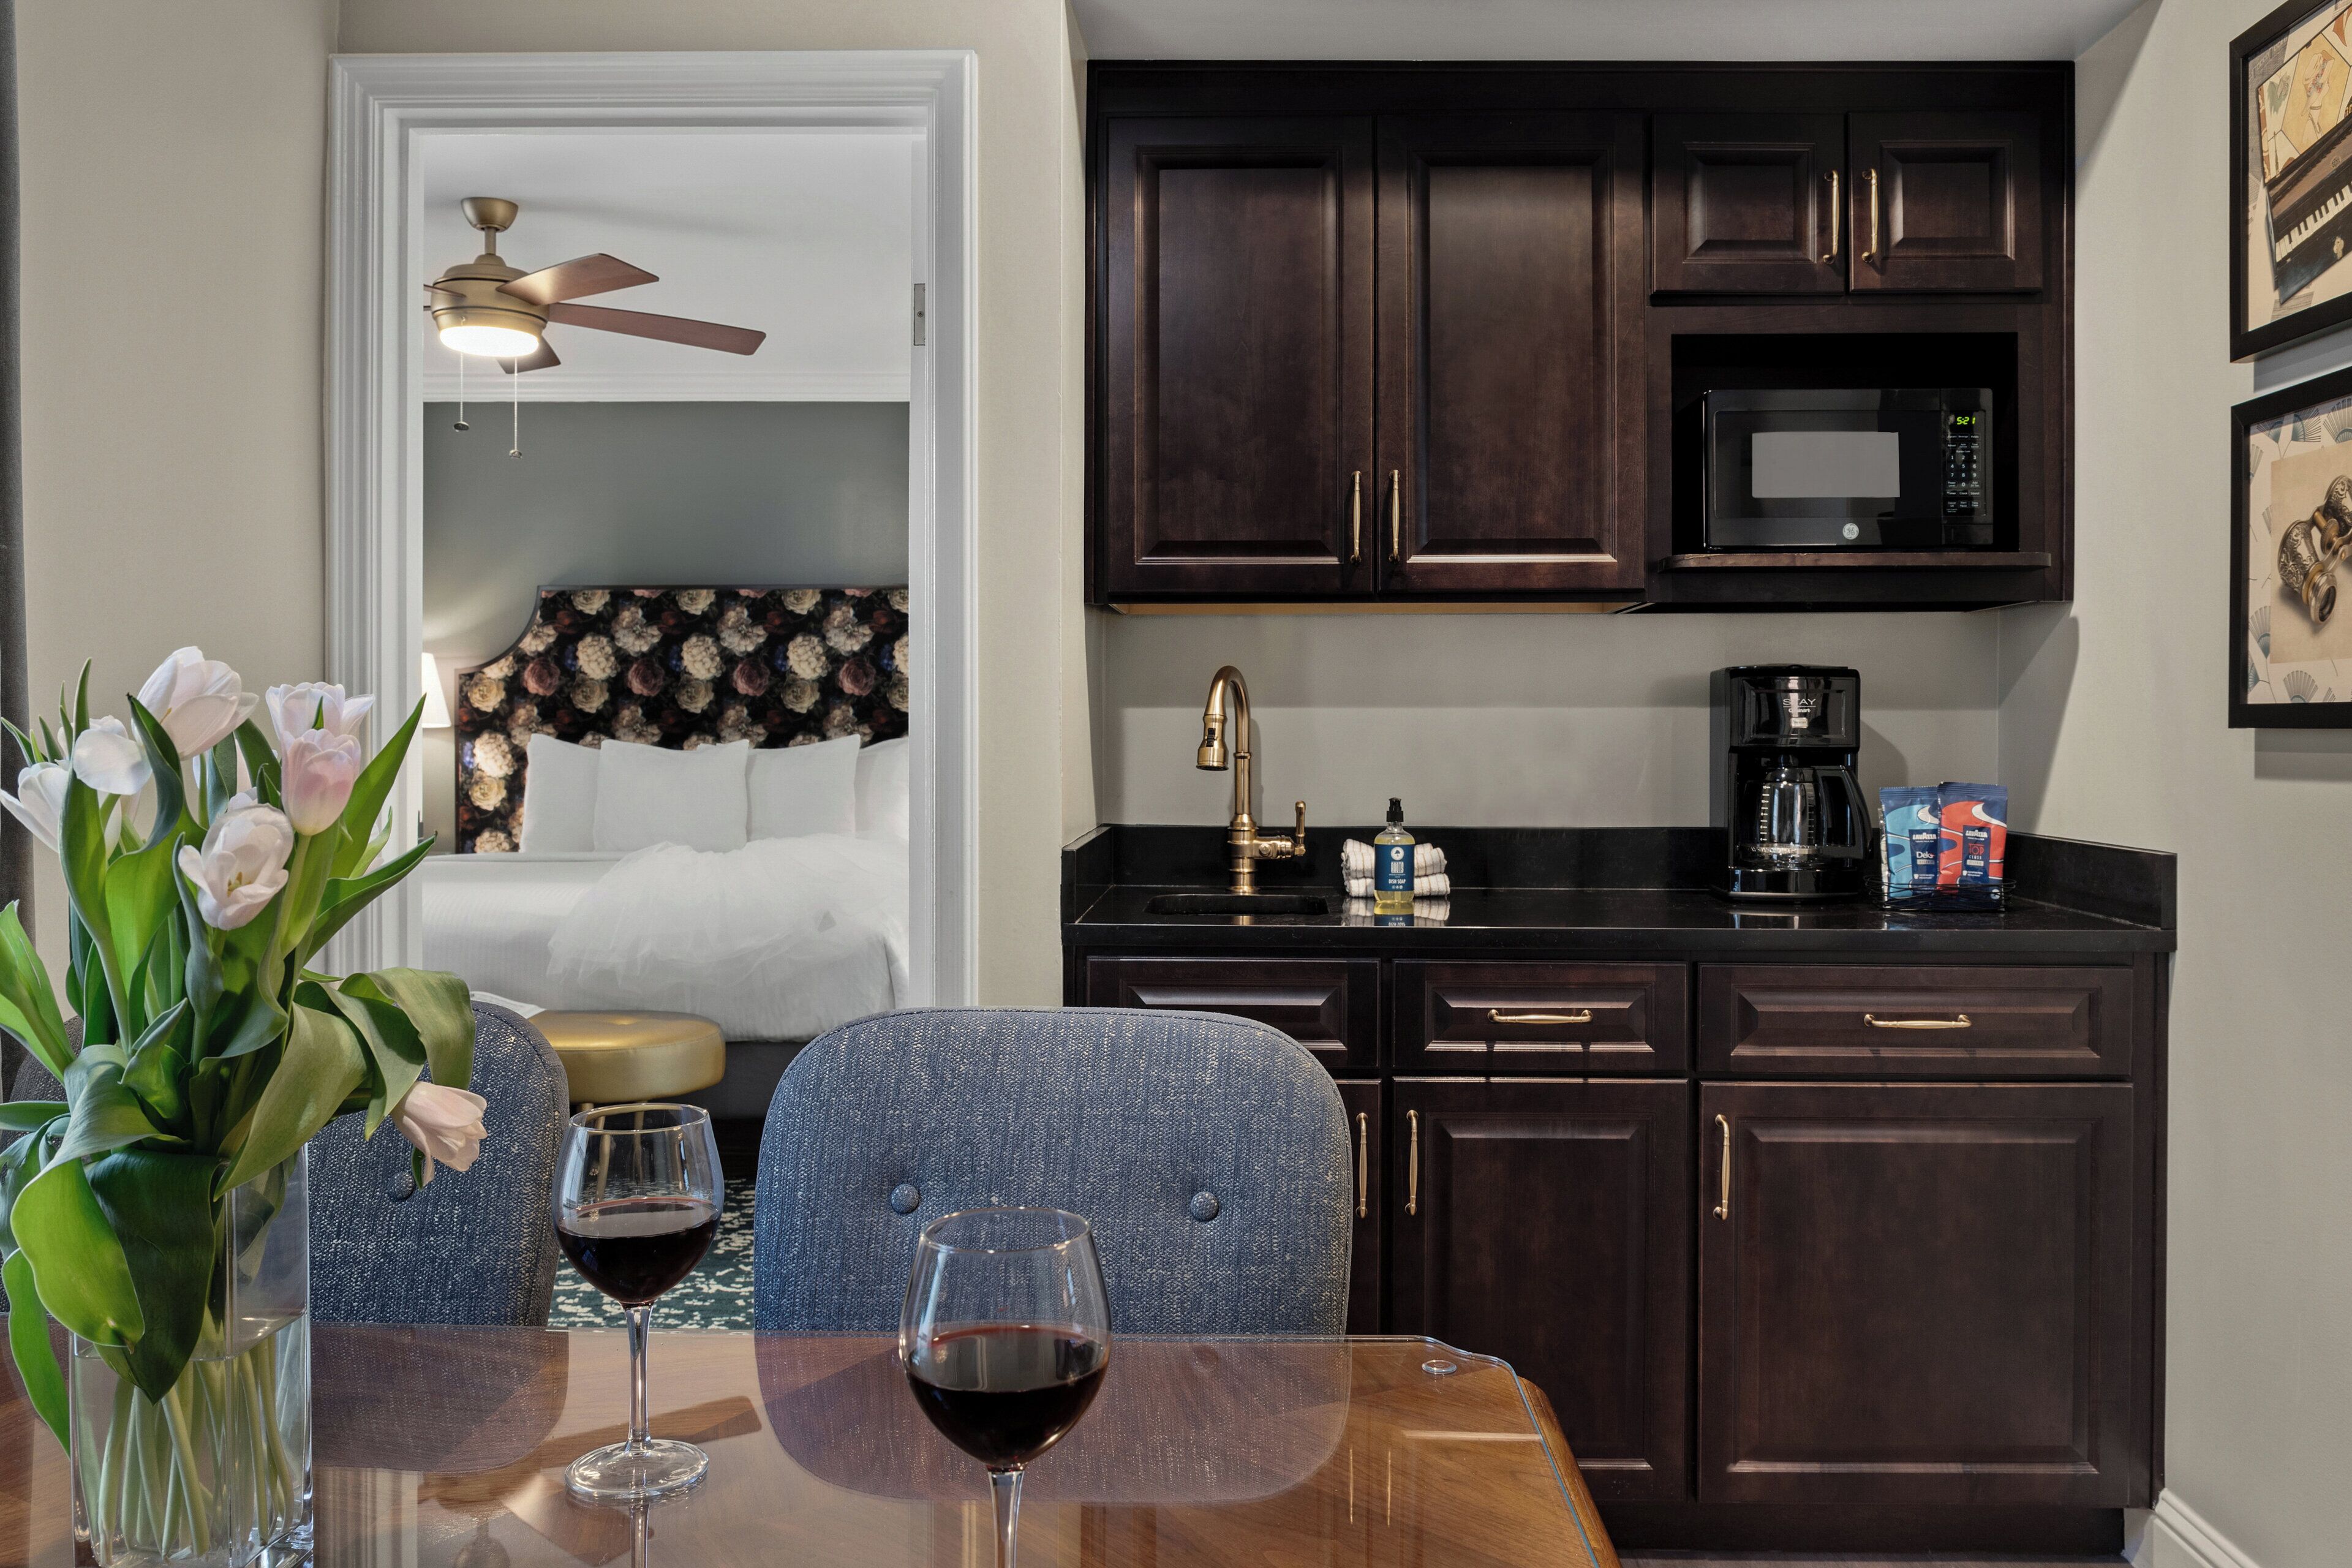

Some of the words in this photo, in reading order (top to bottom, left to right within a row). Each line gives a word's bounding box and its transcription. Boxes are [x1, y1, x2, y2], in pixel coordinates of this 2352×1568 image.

[1956, 416, 1976, 425] 5:21
[1965, 829, 1988, 838] LAVAZZA
[1968, 843, 1985, 855] TOP
[1390, 861, 1404, 873] ROOTS
